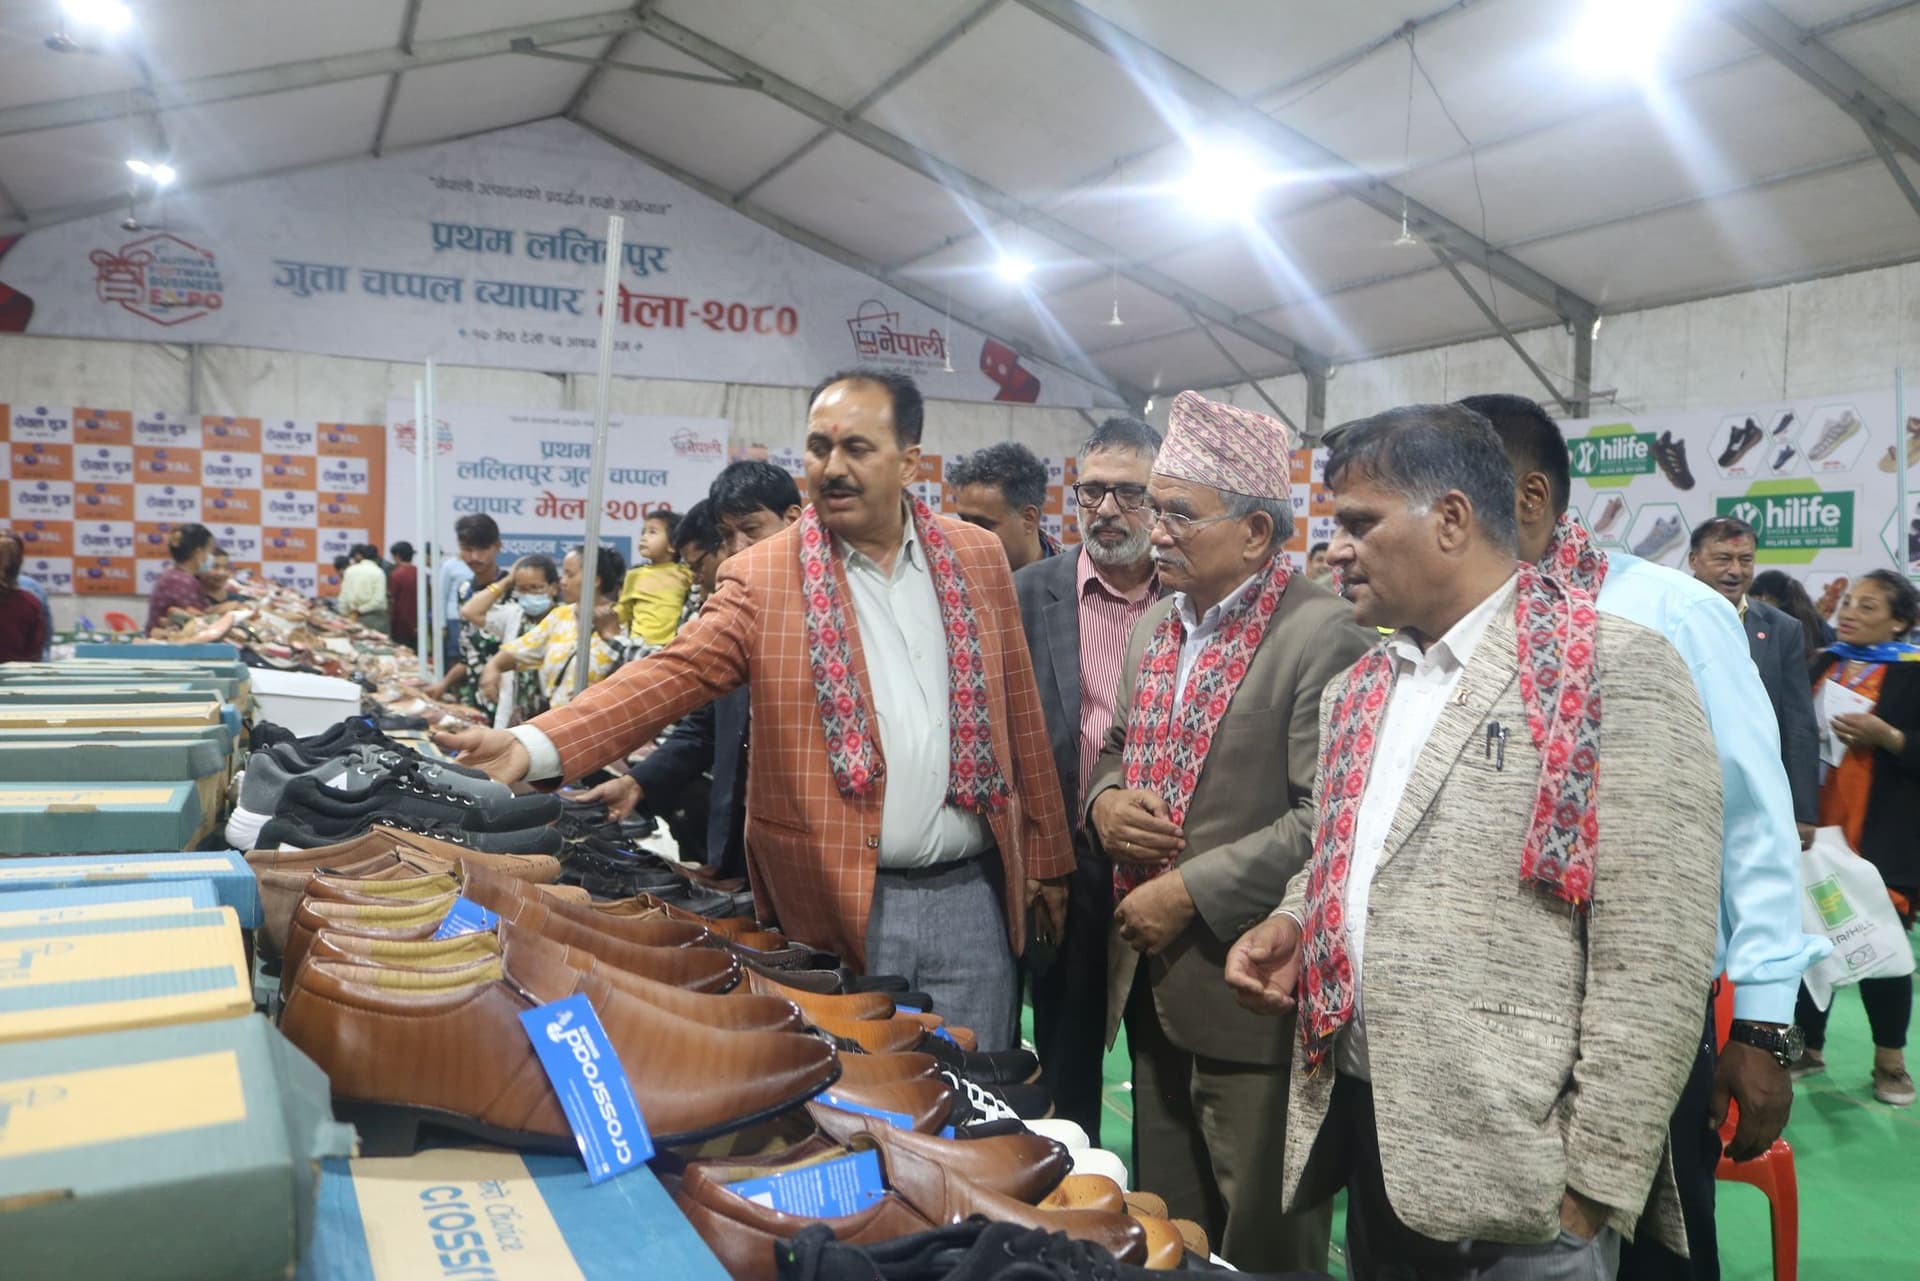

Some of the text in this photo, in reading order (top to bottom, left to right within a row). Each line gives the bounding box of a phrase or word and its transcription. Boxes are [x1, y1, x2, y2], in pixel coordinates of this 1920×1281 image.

[431, 219, 513, 256] प्रथम
[272, 258, 347, 300] जुत्ता
[361, 267, 462, 305] चप्पल
[475, 277, 583, 316] व्यापार
[877, 324, 946, 359] नेपाली
[540, 439, 592, 460] प्रथम
[1600, 437, 1650, 461] hilife
[456, 457, 553, 484] ललितपुर
[609, 468, 668, 489] चप्पल
[453, 494, 525, 516] व्यापार
[1766, 496, 1841, 527] hilife
[557, 1028, 631, 1164] crossroad
